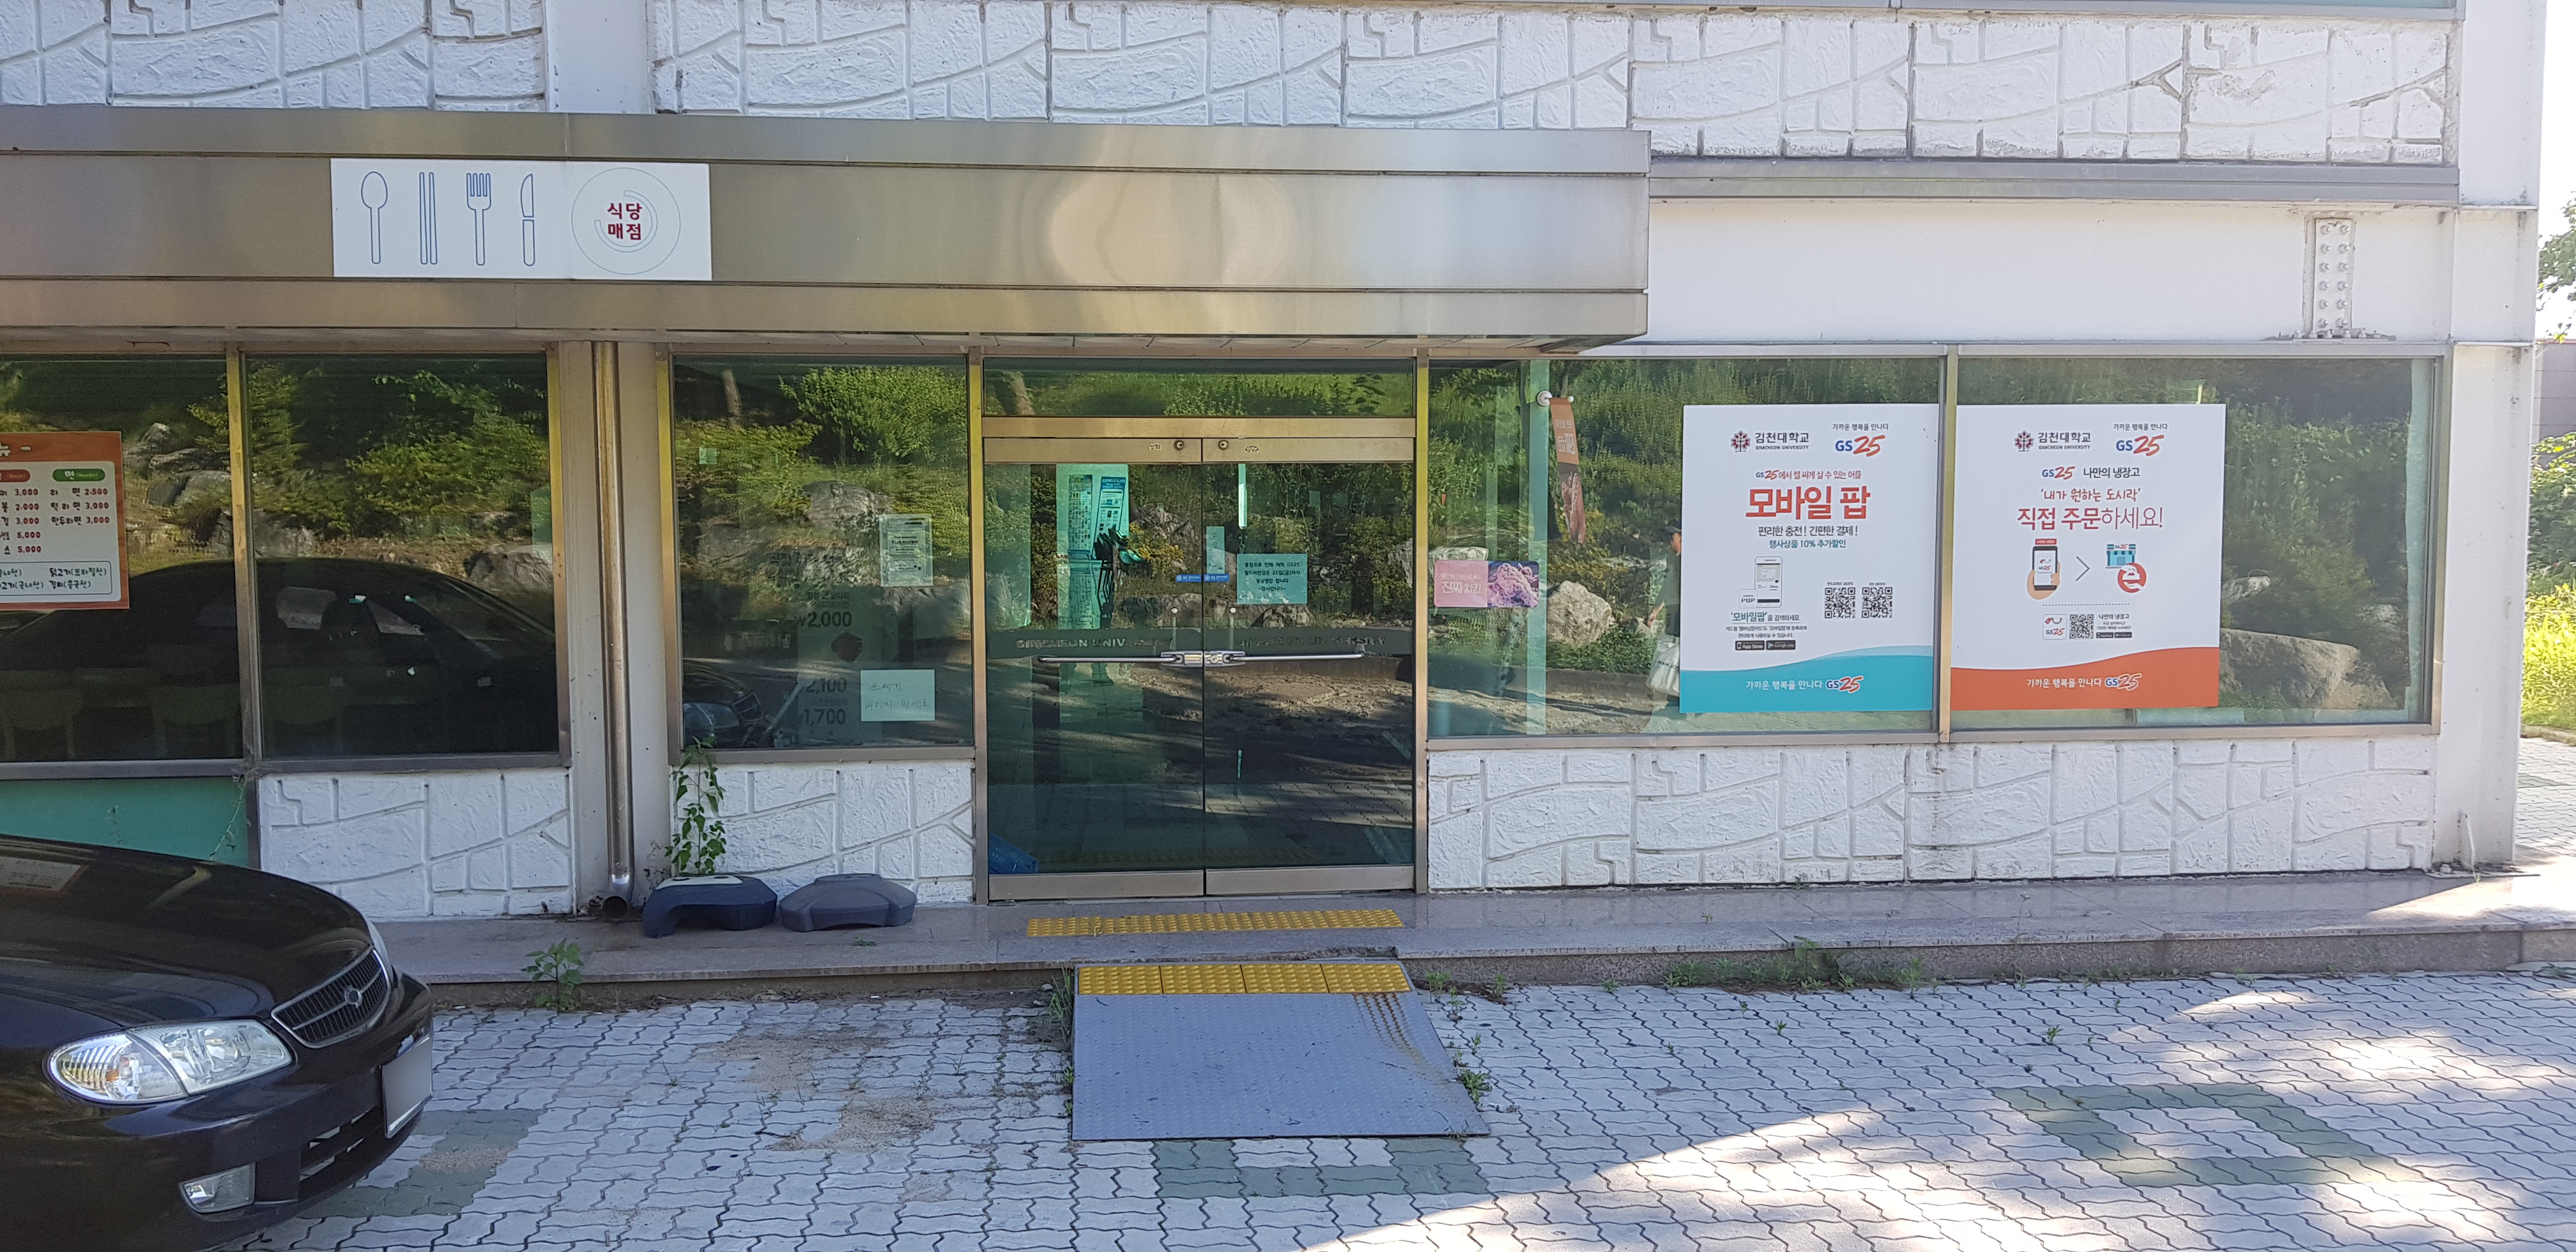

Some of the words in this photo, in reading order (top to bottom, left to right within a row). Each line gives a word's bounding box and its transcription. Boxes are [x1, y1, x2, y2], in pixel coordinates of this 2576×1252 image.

[607, 202, 642, 220] 식당
[608, 223, 641, 240] 매점
[1755, 432, 1809, 443] 김천대학교
[2038, 432, 2090, 443] 김천대학교
[1835, 434, 1885, 457] GS25
[2115, 435, 2165, 456] GS25
[1824, 471, 1832, 479] 수
[1833, 471, 1846, 479] 있는
[2042, 466, 2075, 480] GS25
[2083, 467, 2110, 478] 나만의
[2113, 467, 2140, 478] 냉장고
[2041, 488, 2067, 500] '내가
[2070, 488, 2101, 502] 원하는
[2106, 487, 2141, 501] 도시락'
[1745, 486, 1831, 520] 모바일
[1839, 486, 1871, 519] 팝
[2018, 507, 2055, 530] 직접
[2061, 507, 2163, 530] 주문하세요!
[1758, 526, 1783, 537] 편리한
[1809, 525, 1835, 537] 간편한
[1769, 540, 1798, 549] 행사상품
[1817, 539, 1846, 548] 추가할인
[0, 581, 43, 590] 고기(국내산)
[1442, 581, 1463, 594] 진짜
[1464, 583, 1482, 593] 치킨
[1745, 680, 1770, 690] 가까운
[1772, 680, 1796, 691] 행복을
[1798, 680, 1822, 690] 만나다
[1825, 675, 1864, 693] GS25
[2027, 678, 2050, 688] 가까운
[2052, 678, 2076, 688] 행복을
[2078, 678, 2101, 687] 만나다
[2105, 672, 2142, 691] GS25
